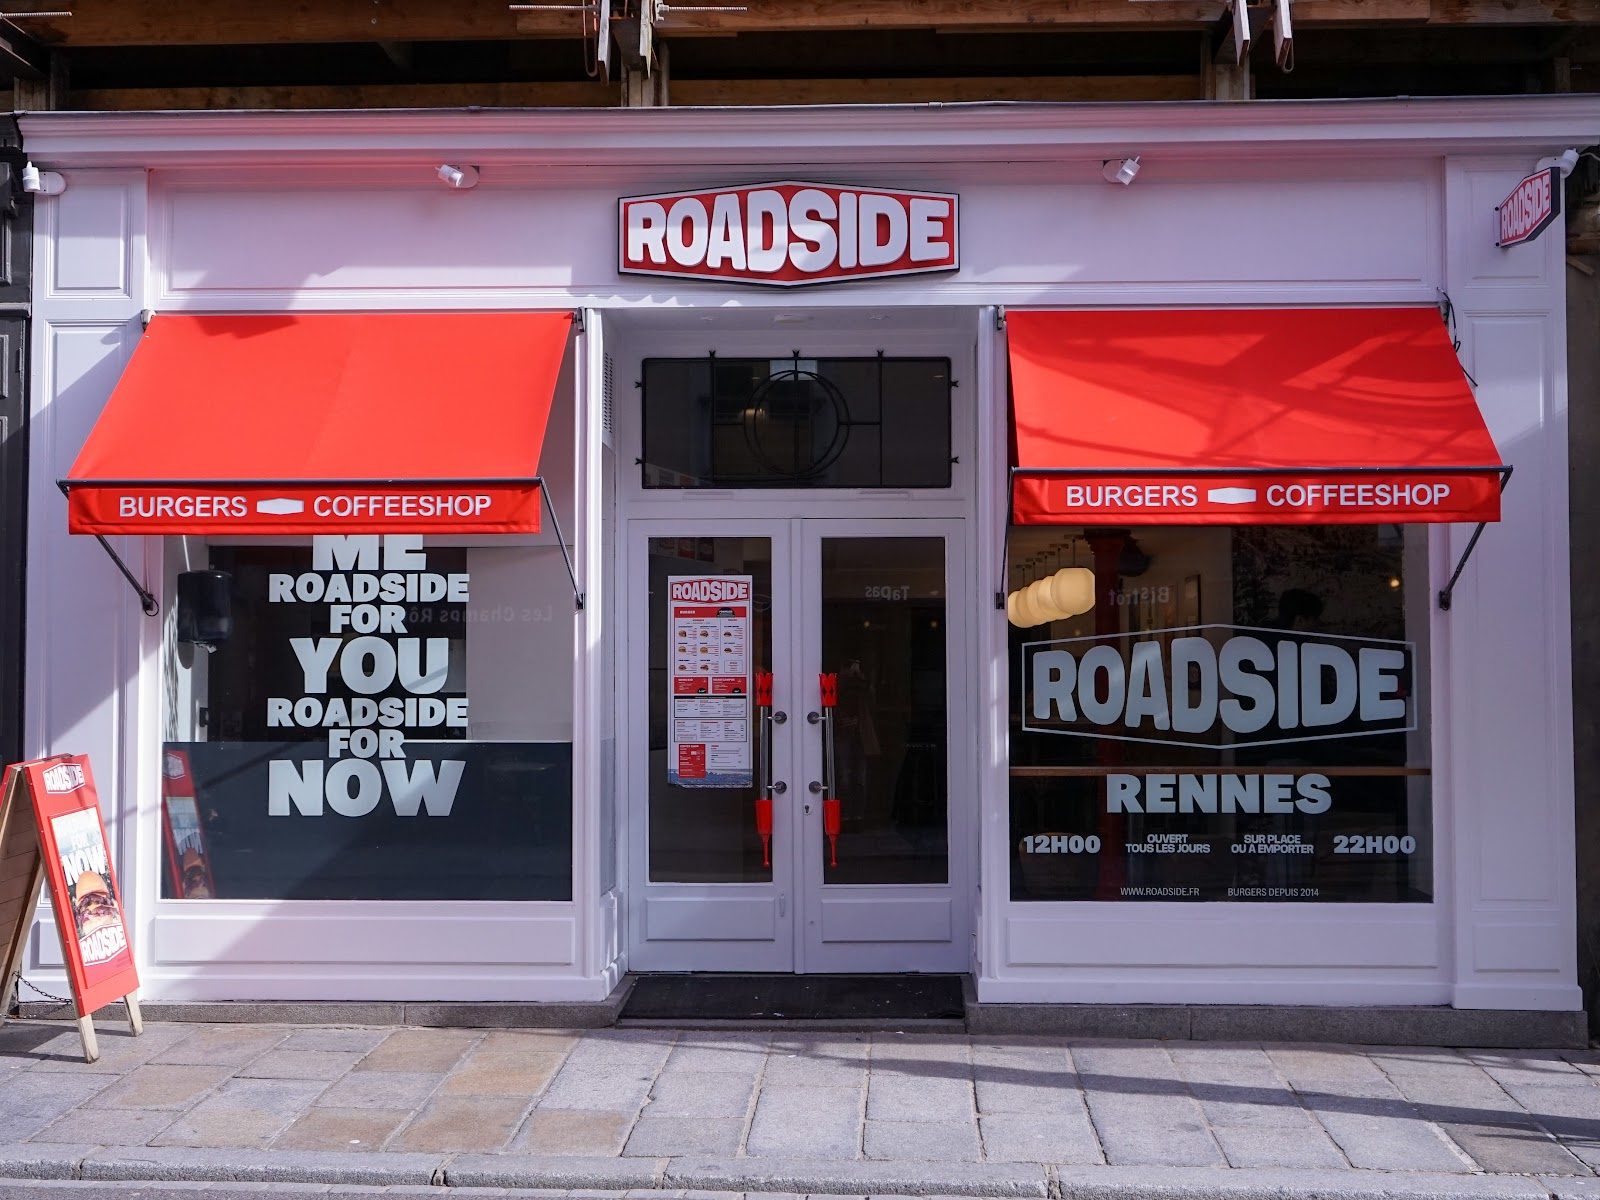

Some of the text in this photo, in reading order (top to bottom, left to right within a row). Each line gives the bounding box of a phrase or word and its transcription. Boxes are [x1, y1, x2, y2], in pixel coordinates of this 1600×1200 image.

[1501, 174, 1550, 240] ROADSIDE
[627, 189, 951, 273] ROADSIDE
[119, 495, 492, 518] BURGERS COFFEESHOP
[1065, 483, 1451, 508] BURGERS COFFEESHOP
[312, 534, 427, 571] ME
[268, 573, 470, 603] ROADSIDE
[672, 581, 748, 601] ROADSIDE
[329, 604, 408, 634] FOR
[289, 636, 449, 694] YOU
[1033, 635, 1406, 734] ROADSIDE
[267, 697, 469, 728] ROADSIDE
[328, 728, 405, 759] FOR
[44, 765, 84, 791] ROADSIDE
[268, 759, 466, 817] NOW
[1106, 773, 1332, 814] RENNES
[1024, 835, 1101, 854] 12H00
[1125, 843, 1211, 854] TOUS LES JOURS
[1146, 833, 1189, 844] OUVERT
[1230, 843, 1247, 854] OU
[1257, 843, 1315, 855] EMPORTER
[1243, 834, 1302, 844] SUR PLACE
[1333, 834, 1417, 855] 22H00
[61, 844, 107, 887] NOW
[1120, 887, 1200, 897] WWW.ROADSIDE.FR
[1227, 887, 1320, 897] BURGERS DEPUIS 2014
[80, 926, 128, 963] ROADSIDE
